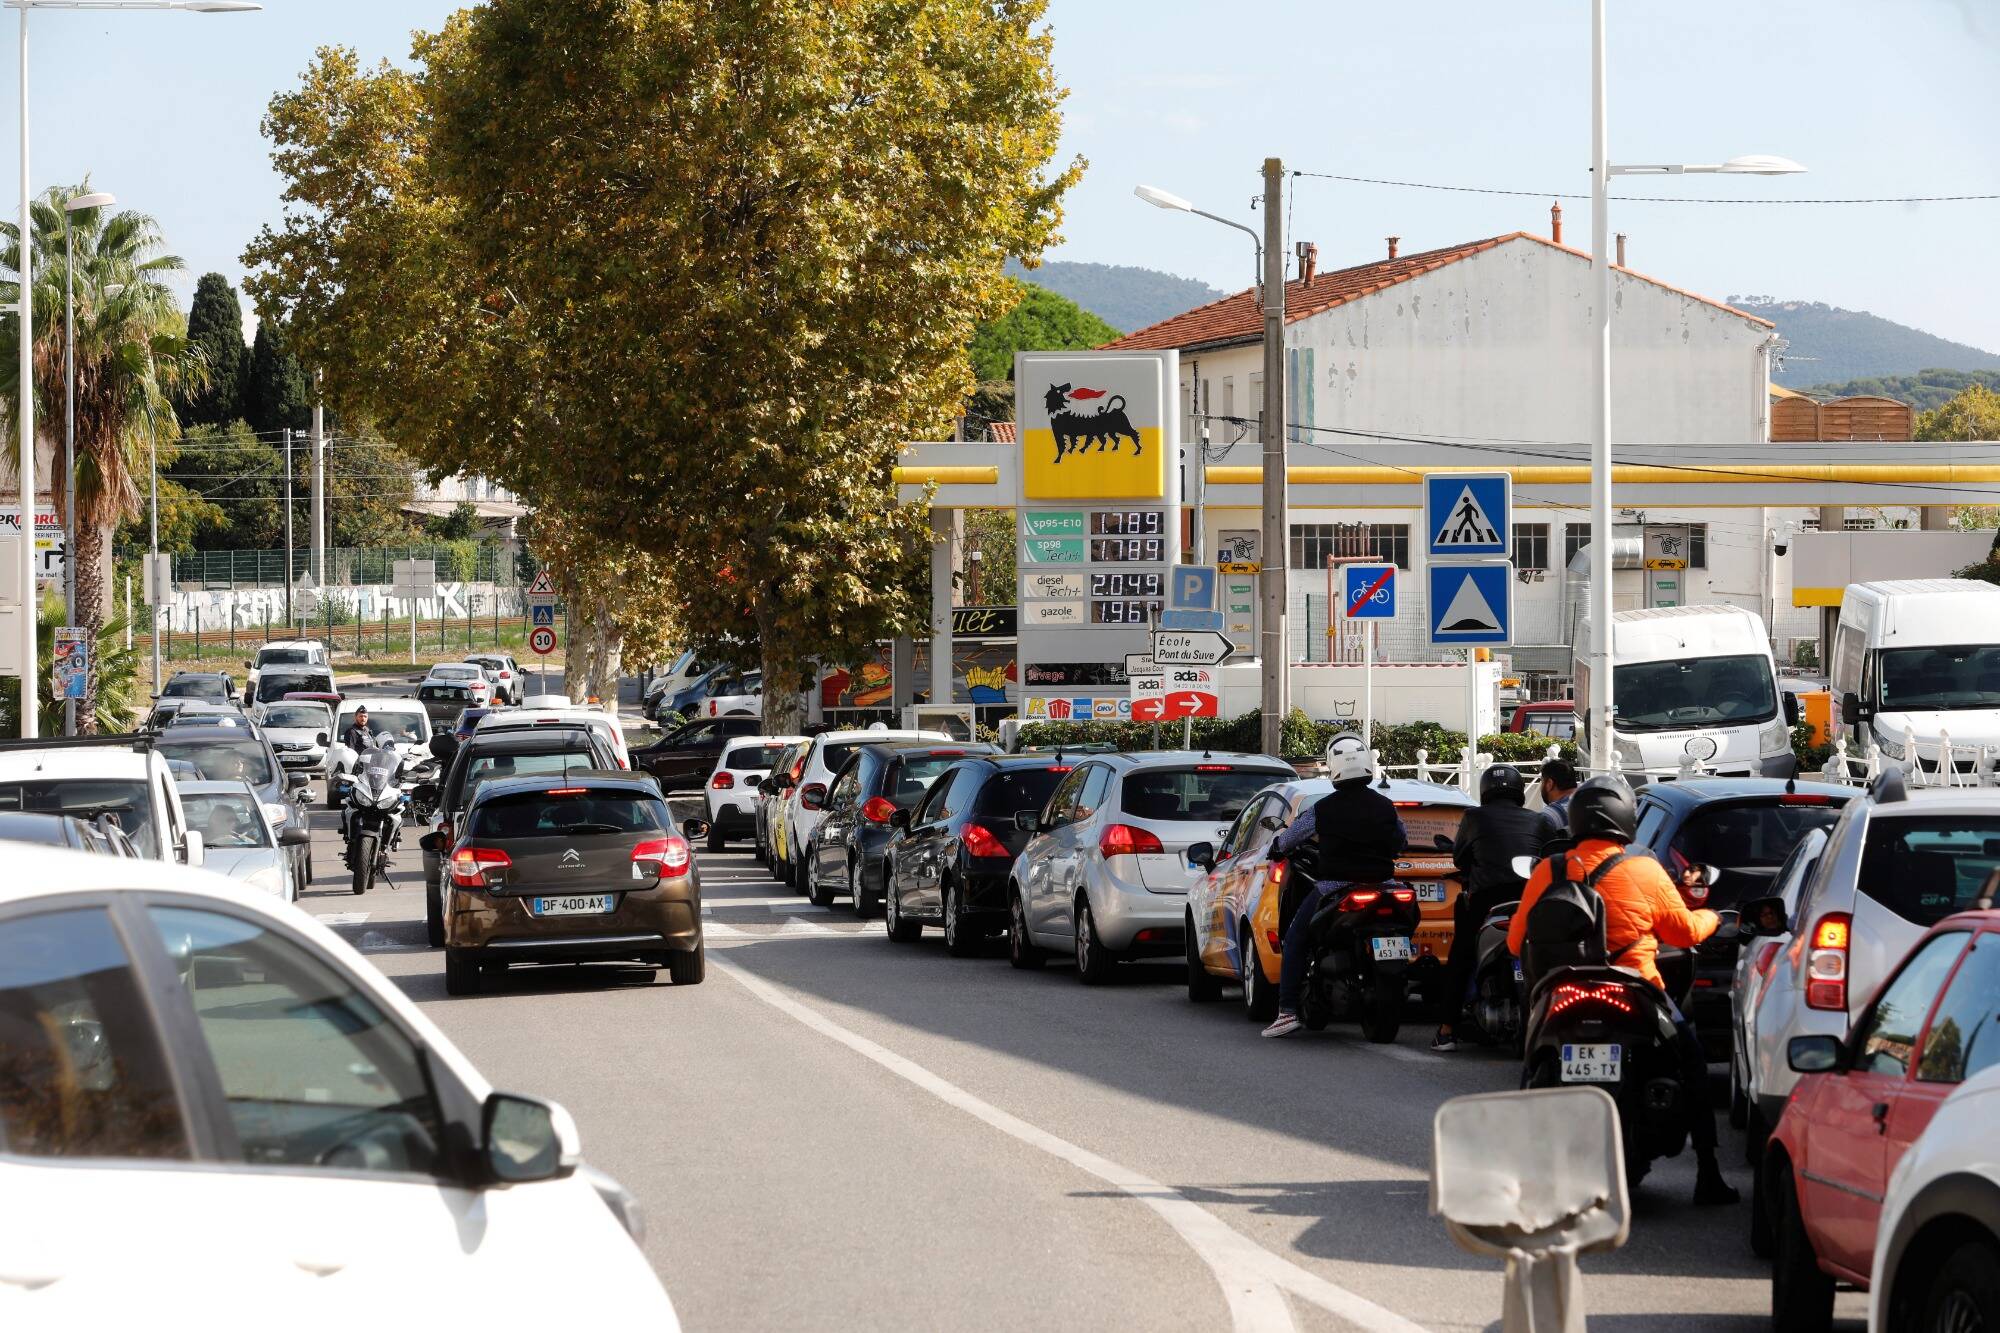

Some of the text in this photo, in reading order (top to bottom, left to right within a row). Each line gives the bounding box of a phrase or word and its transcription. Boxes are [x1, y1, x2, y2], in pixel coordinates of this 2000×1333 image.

[1033, 519, 1081, 530] sp95-E10
[1101, 512, 1159, 534] 1.789
[1038, 540, 1061, 552] sp98
[1101, 539, 1159, 561] 1.789
[1037, 575, 1064, 585] diesel
[1092, 574, 1159, 596] 2.049
[1045, 585, 1081, 597] Tech+
[1183, 574, 1204, 601] P
[1040, 606, 1073, 618] gazole
[536, 634, 550, 646] 30
[1159, 634, 1191, 646] École
[1158, 649, 1215, 660] Pont du Suve
[1173, 670, 1197, 682] ada
[1138, 679, 1159, 690] ada
[542, 896, 604, 912] DF-400-AX
